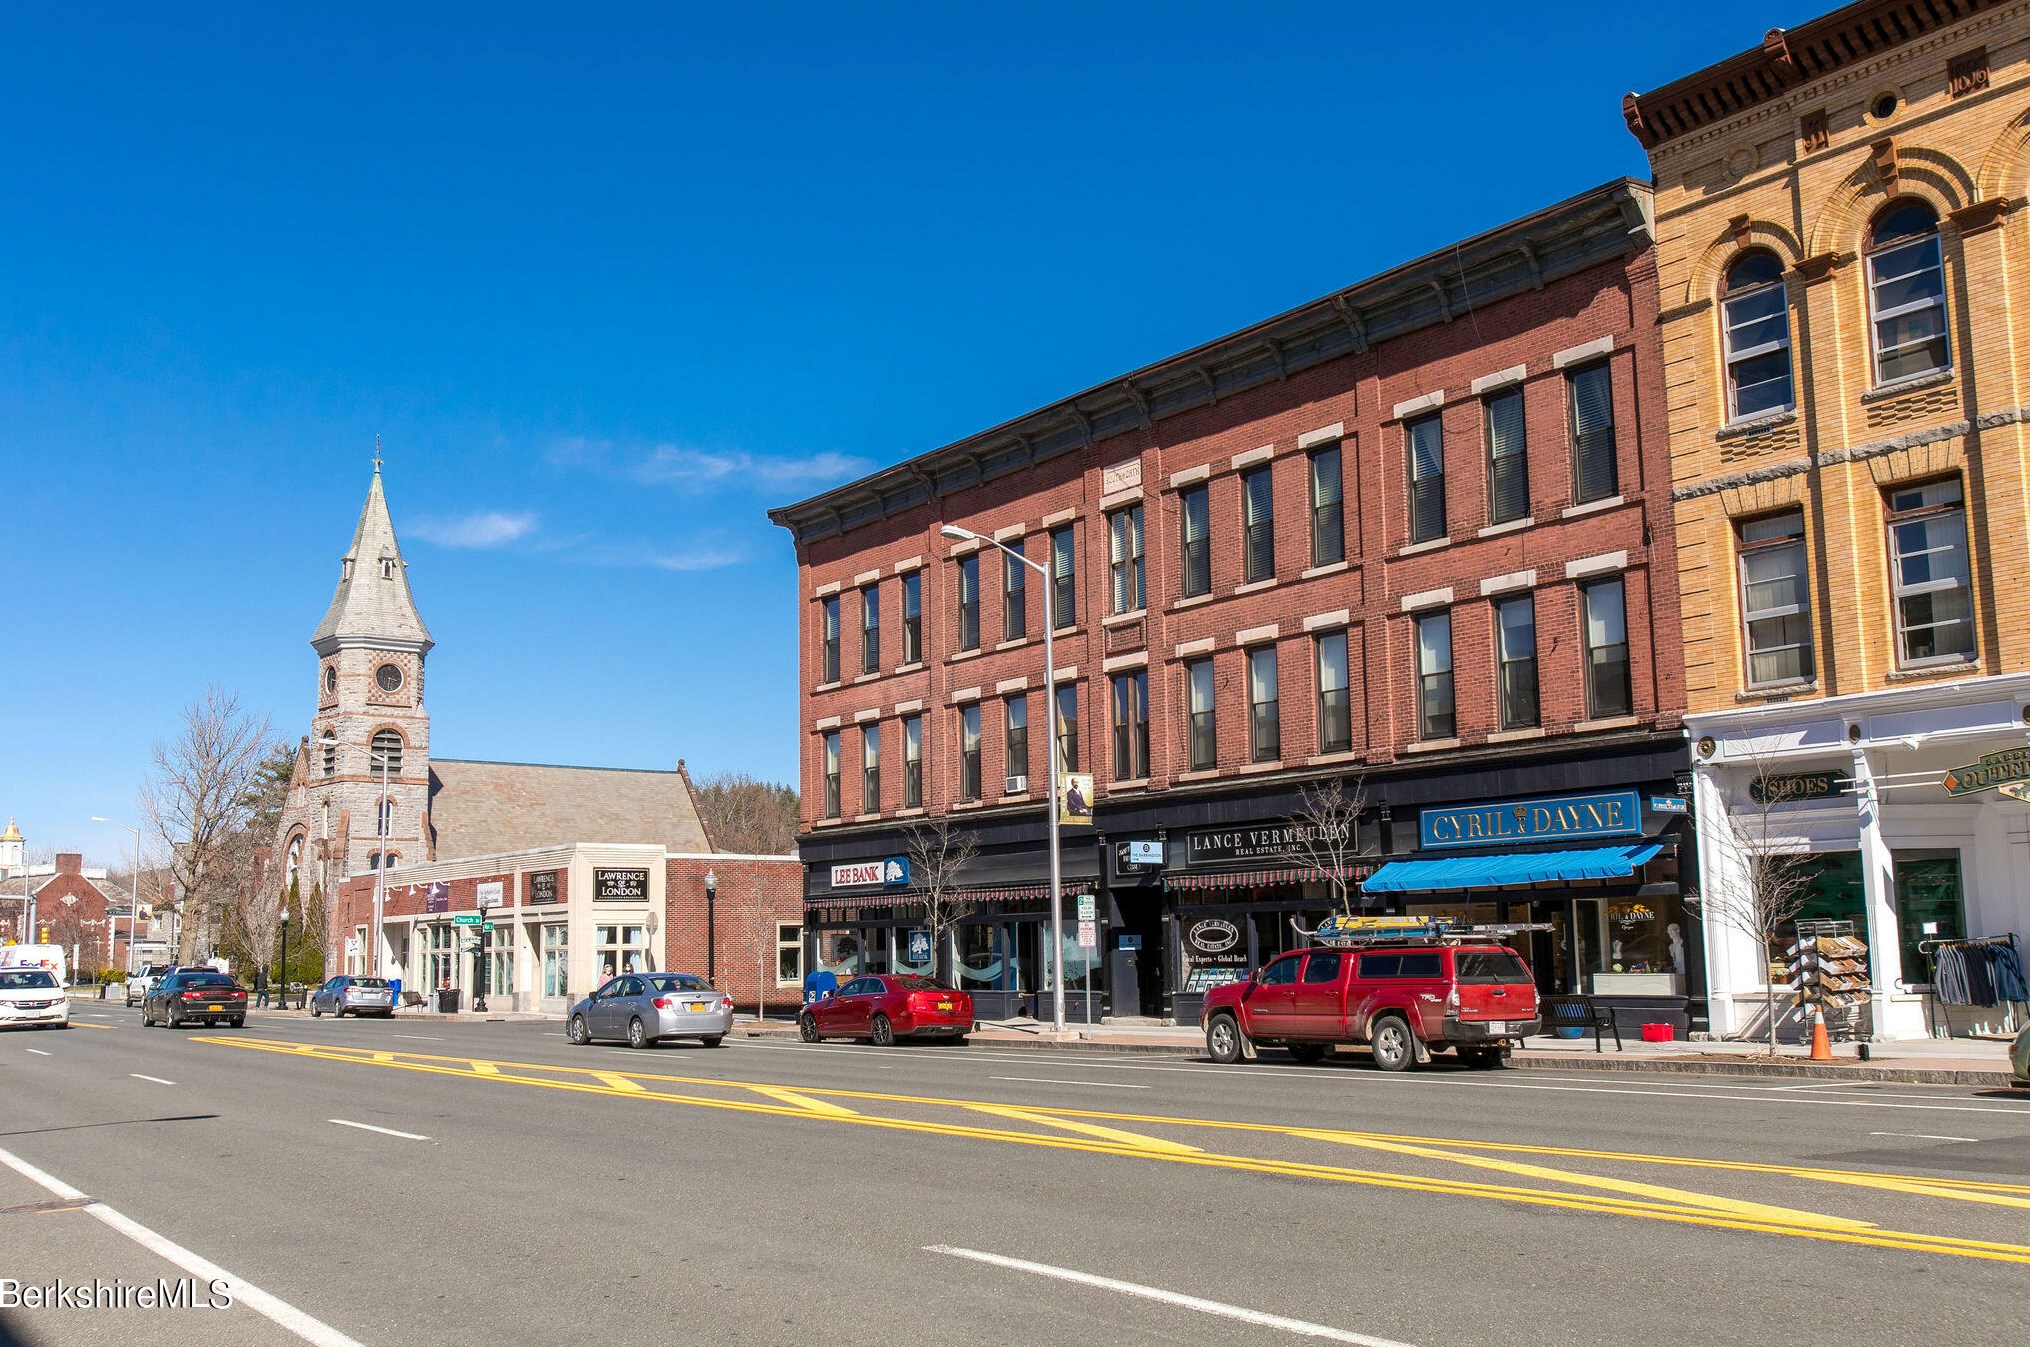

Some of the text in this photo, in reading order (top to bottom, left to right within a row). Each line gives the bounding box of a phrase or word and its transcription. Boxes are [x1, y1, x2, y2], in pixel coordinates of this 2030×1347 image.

[1767, 777, 1829, 795] SHOES
[1433, 801, 1624, 840] CYRIL & DAYNE
[1194, 824, 1351, 850] LANCE VERMEULEN
[1235, 847, 1253, 856] REAL
[598, 871, 645, 881] LAWRENCE
[835, 866, 879, 884] LEE BANK
[602, 887, 641, 896] LONDON
[1630, 911, 1655, 920] DAYNE
